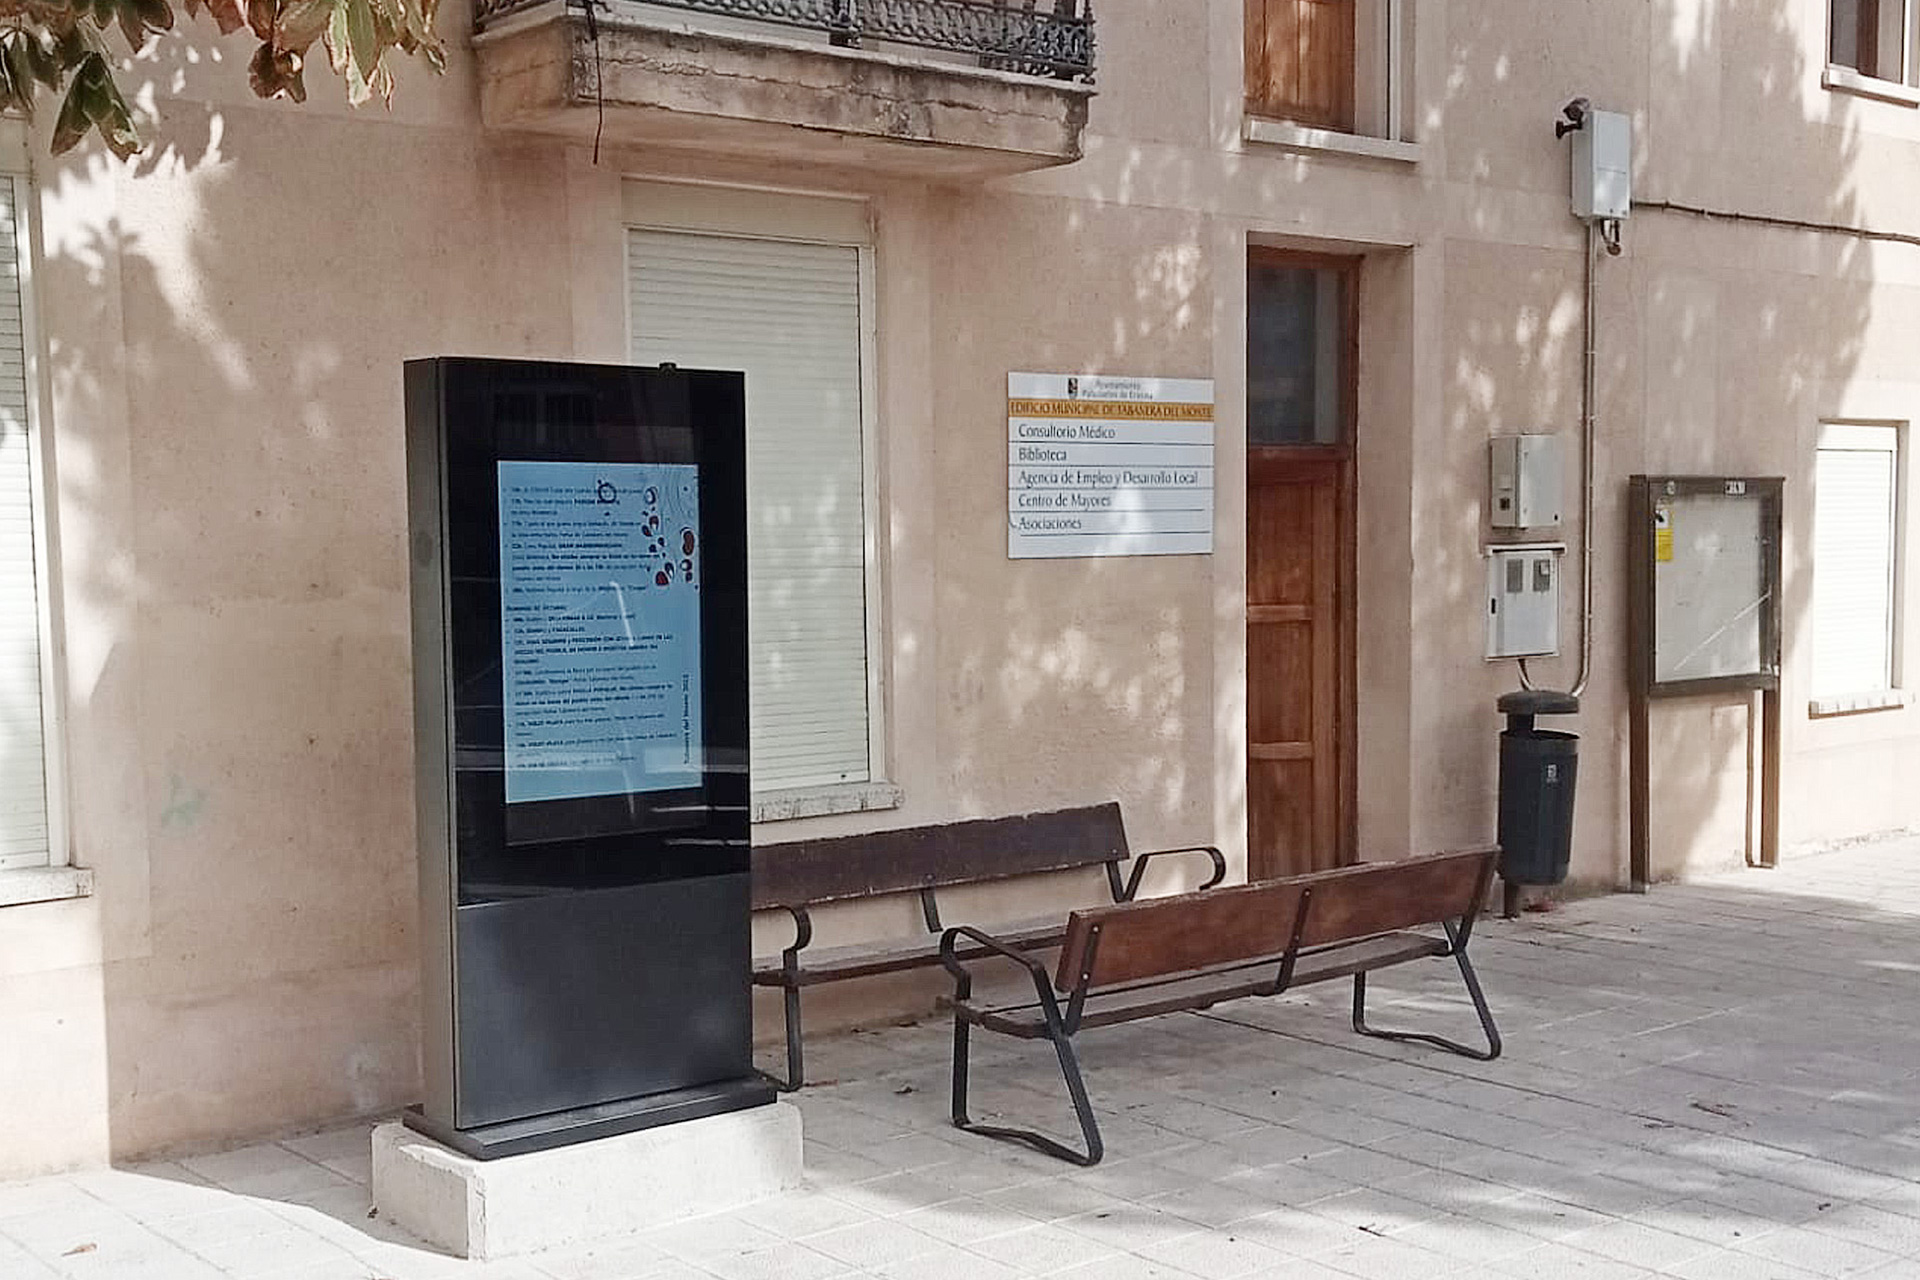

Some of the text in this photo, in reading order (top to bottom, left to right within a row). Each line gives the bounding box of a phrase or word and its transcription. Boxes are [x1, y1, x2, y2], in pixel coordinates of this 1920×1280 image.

[1010, 401, 1212, 418] EDIFICIO MUNICIPAL DE TABANERA DEL MONTE
[1018, 423, 1116, 439] Consultorio Médico
[1018, 447, 1067, 462] Biblioteca
[1018, 471, 1198, 489] Agencia de Empleo y Desarrollo Local
[1018, 493, 1111, 511] Centro de Mayores
[1018, 516, 1082, 530] Asociaciones
